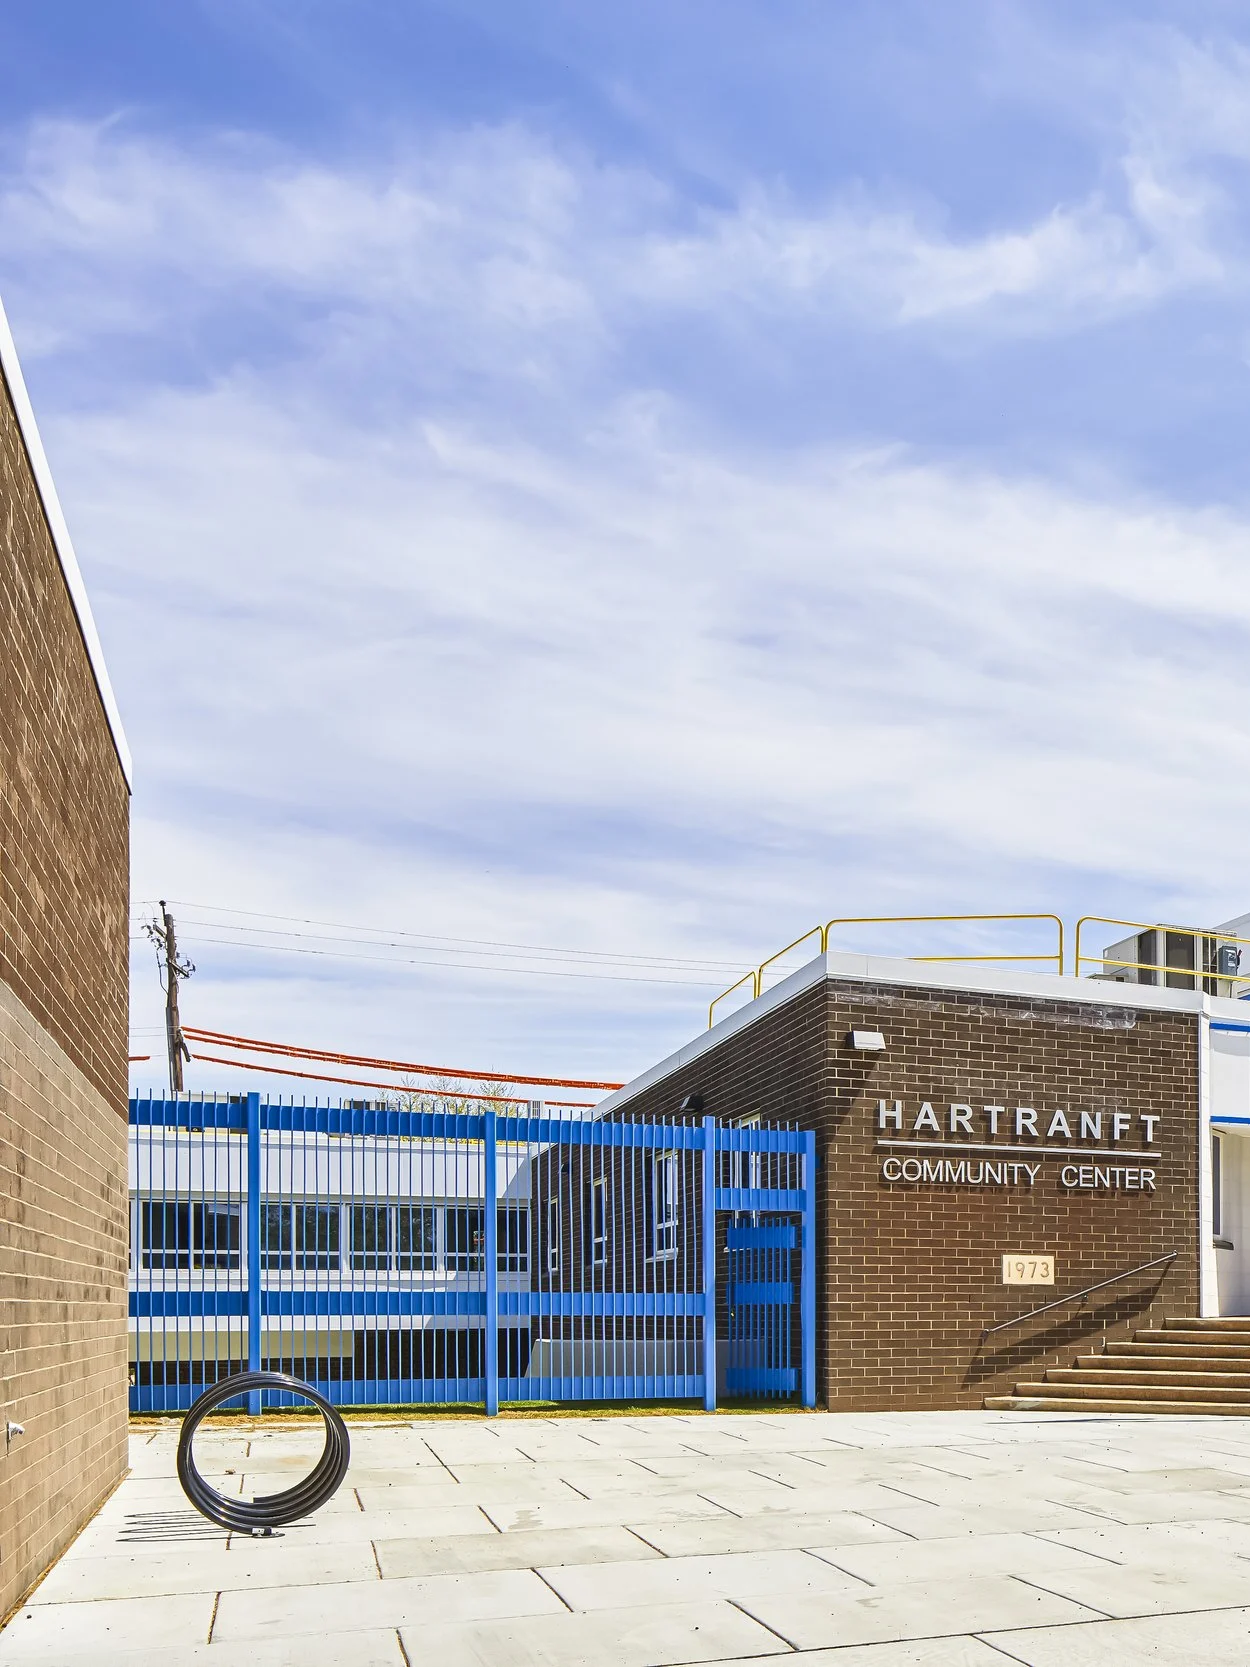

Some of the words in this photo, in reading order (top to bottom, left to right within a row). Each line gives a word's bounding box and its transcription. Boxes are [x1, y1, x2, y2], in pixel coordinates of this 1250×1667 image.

[878, 1099, 1161, 1143] HARTRANFT
[882, 1157, 1041, 1185] COMMUNITY
[1061, 1165, 1156, 1190] CENTER
[1008, 1261, 1050, 1279] 1973
